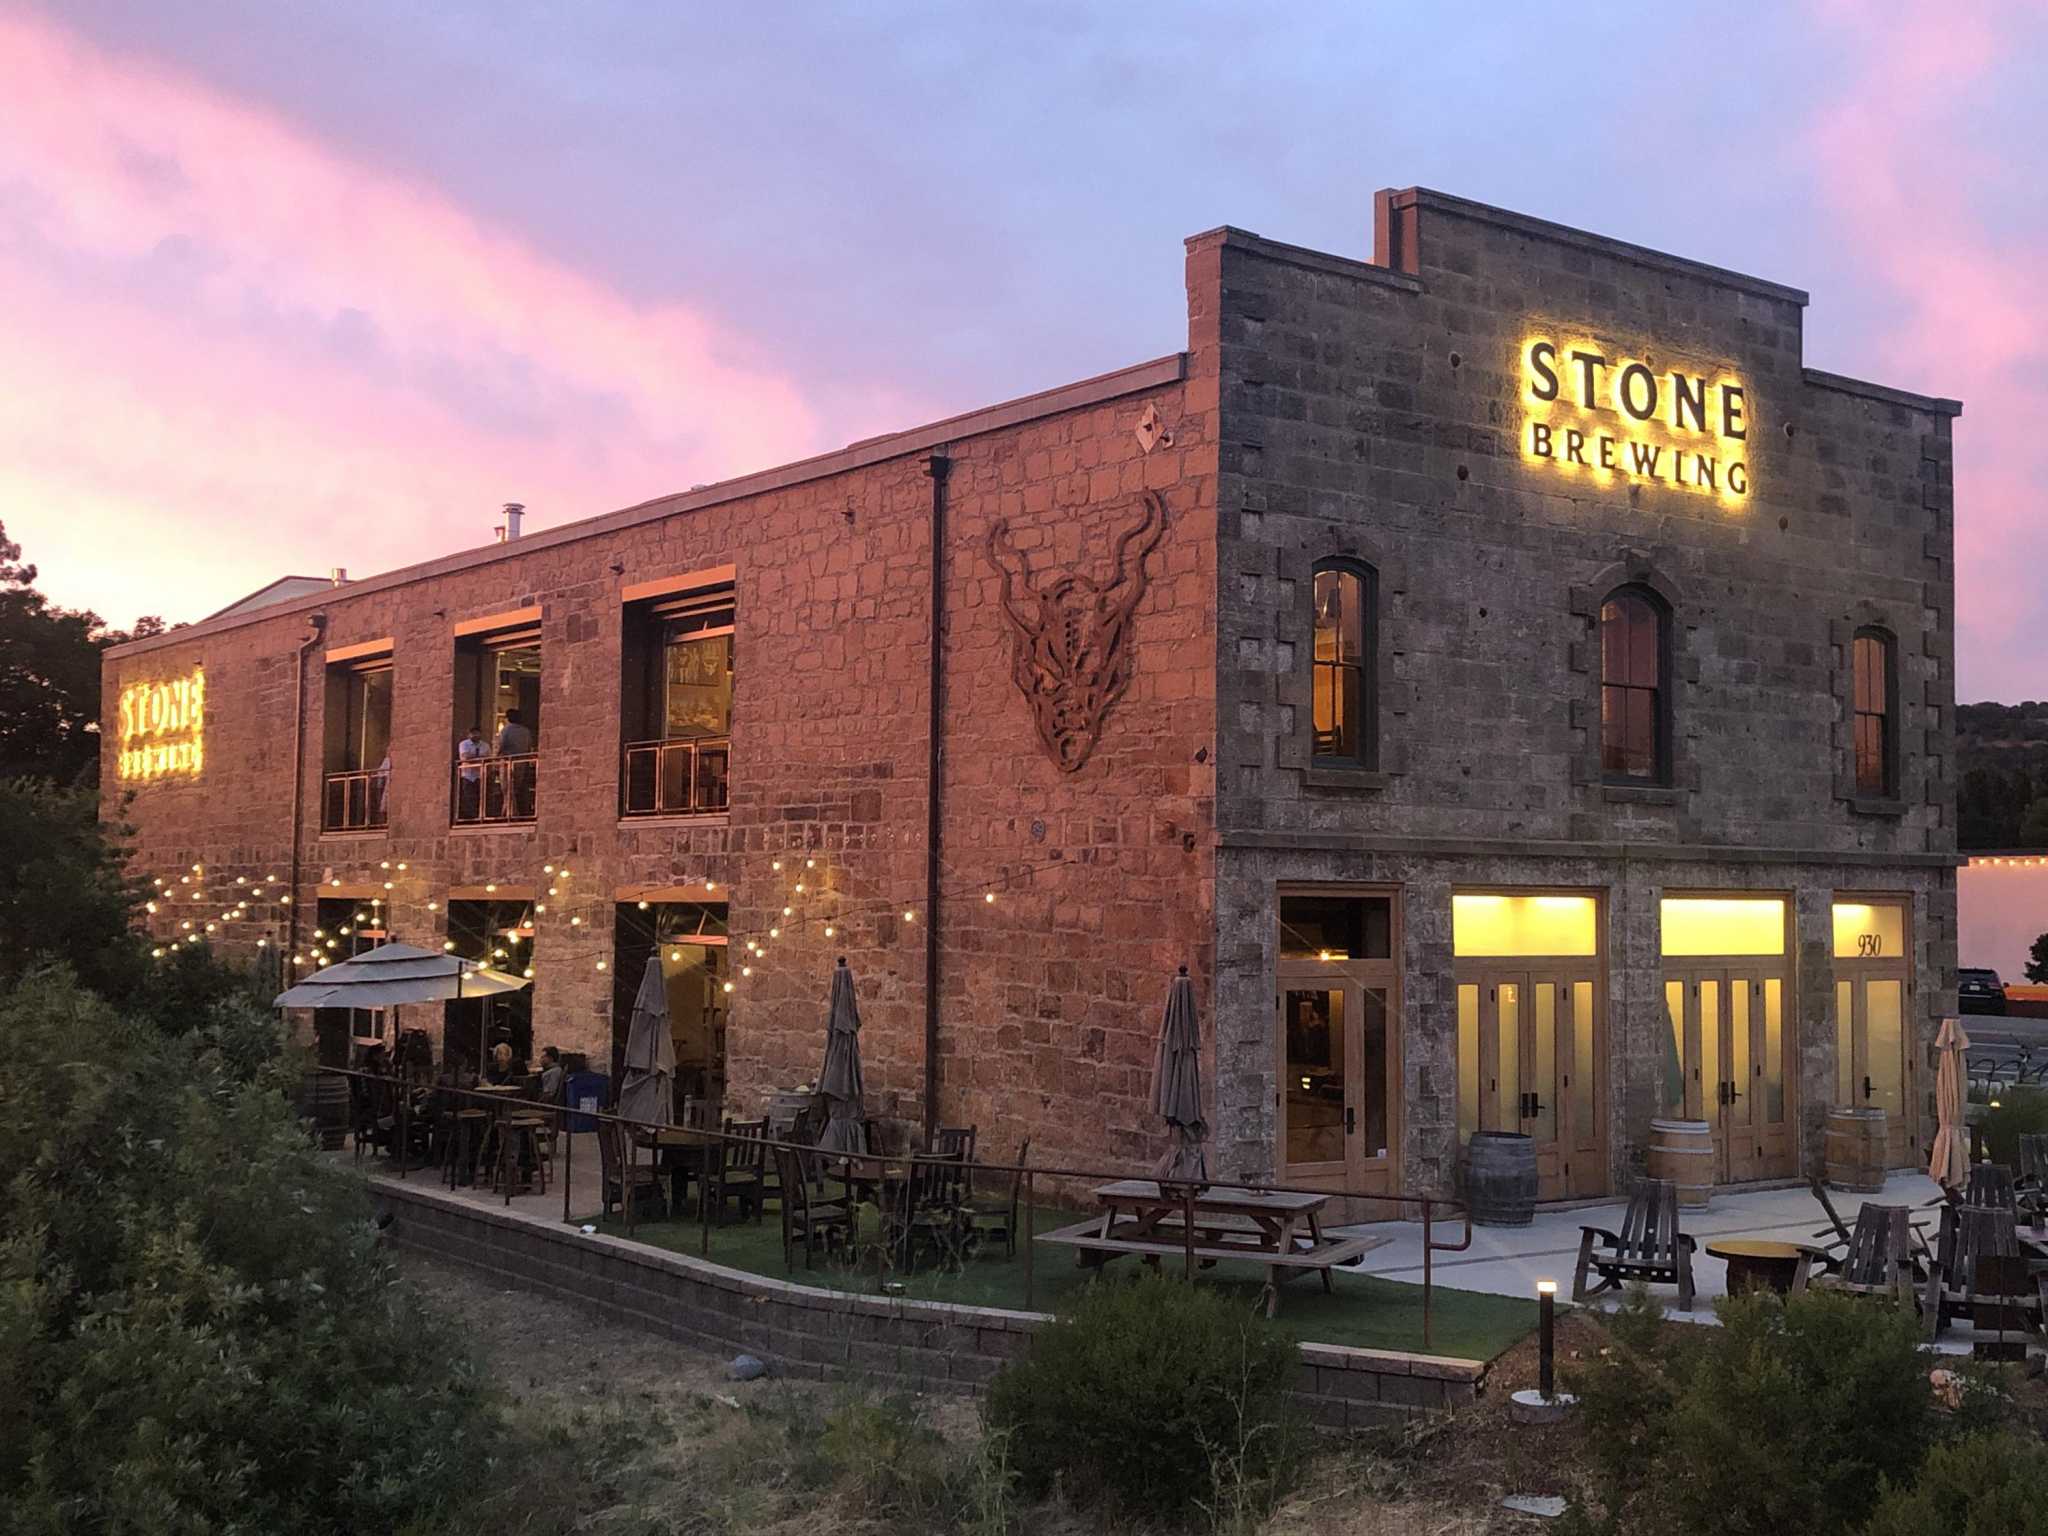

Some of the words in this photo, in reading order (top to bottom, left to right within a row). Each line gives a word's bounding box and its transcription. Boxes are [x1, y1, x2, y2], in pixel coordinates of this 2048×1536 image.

[1531, 342, 1747, 440] STONE
[1533, 423, 1747, 494] BREWING
[118, 675, 204, 741] STONE
[1858, 935, 1882, 957] 930
